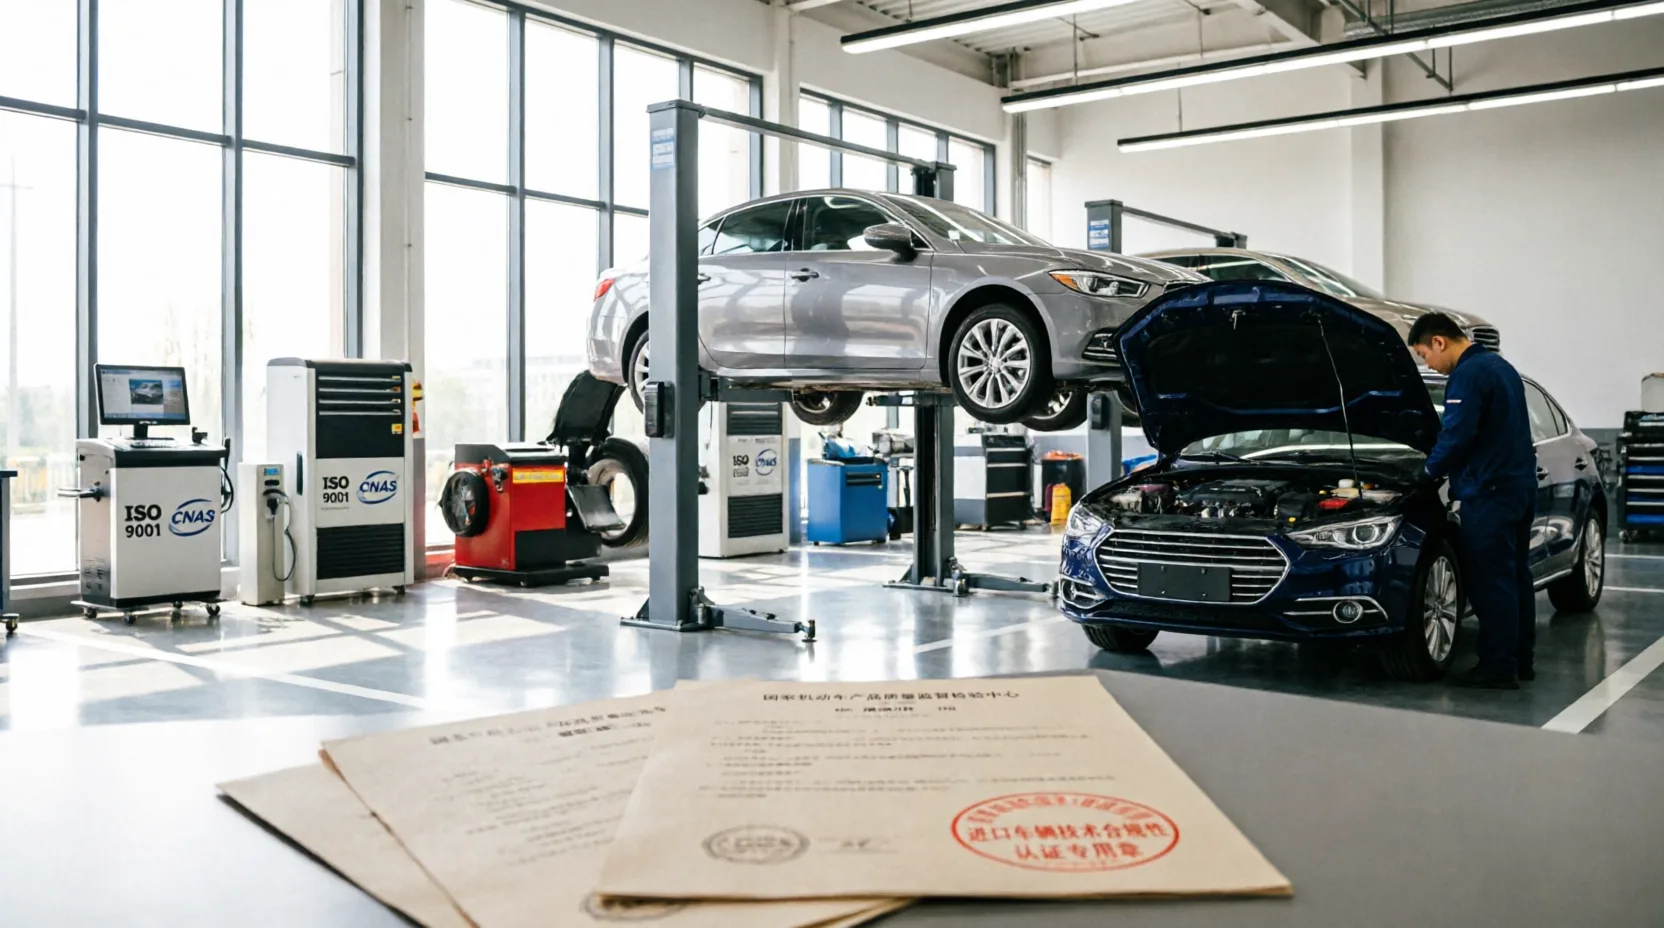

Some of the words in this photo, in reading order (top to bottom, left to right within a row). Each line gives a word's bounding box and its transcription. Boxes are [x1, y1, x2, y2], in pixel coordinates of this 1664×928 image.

[322, 475, 350, 490] ISO
[359, 480, 398, 493] CNAS
[322, 491, 350, 504] 9001
[124, 504, 162, 522] ISO
[171, 509, 216, 525] CNAS
[125, 522, 161, 538] 9001
[1014, 841, 1143, 860] 认证专用章
